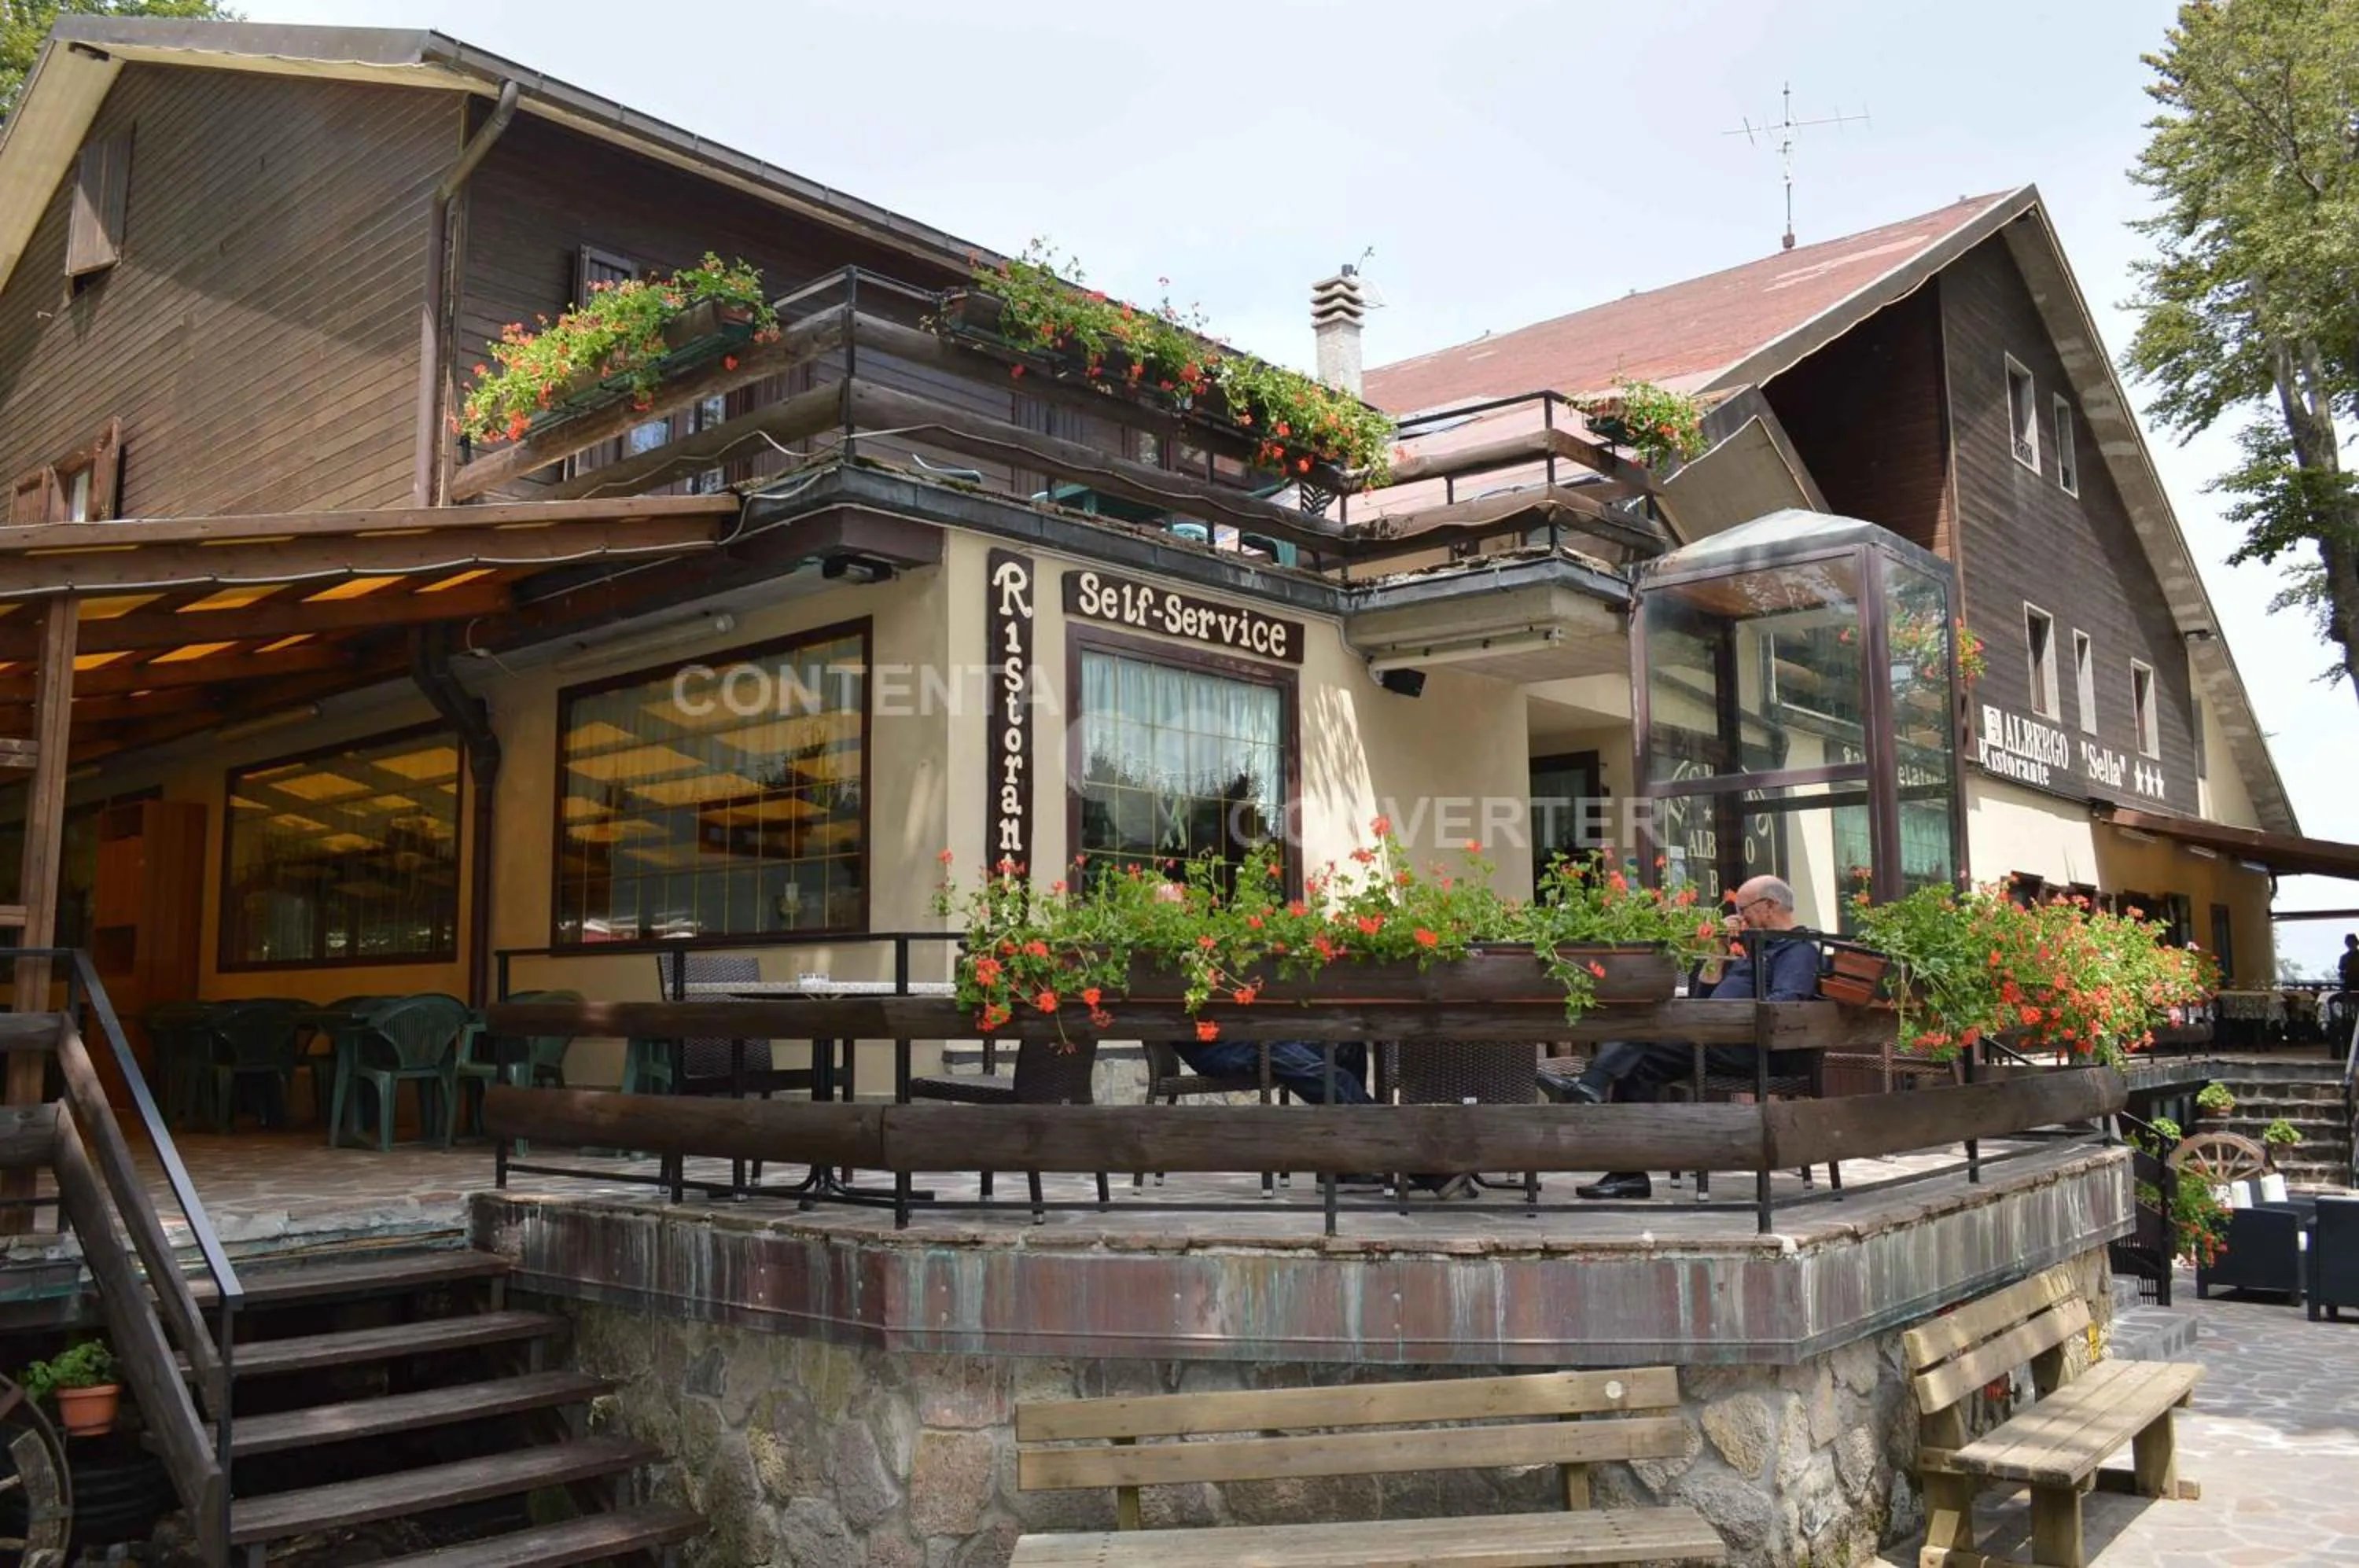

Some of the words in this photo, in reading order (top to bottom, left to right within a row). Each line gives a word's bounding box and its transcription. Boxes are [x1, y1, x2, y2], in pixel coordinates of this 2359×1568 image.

[1079, 572, 1286, 657] Self-Service
[1978, 737, 2049, 786] Ristorante
[2006, 713, 2069, 770] ALBERGO
